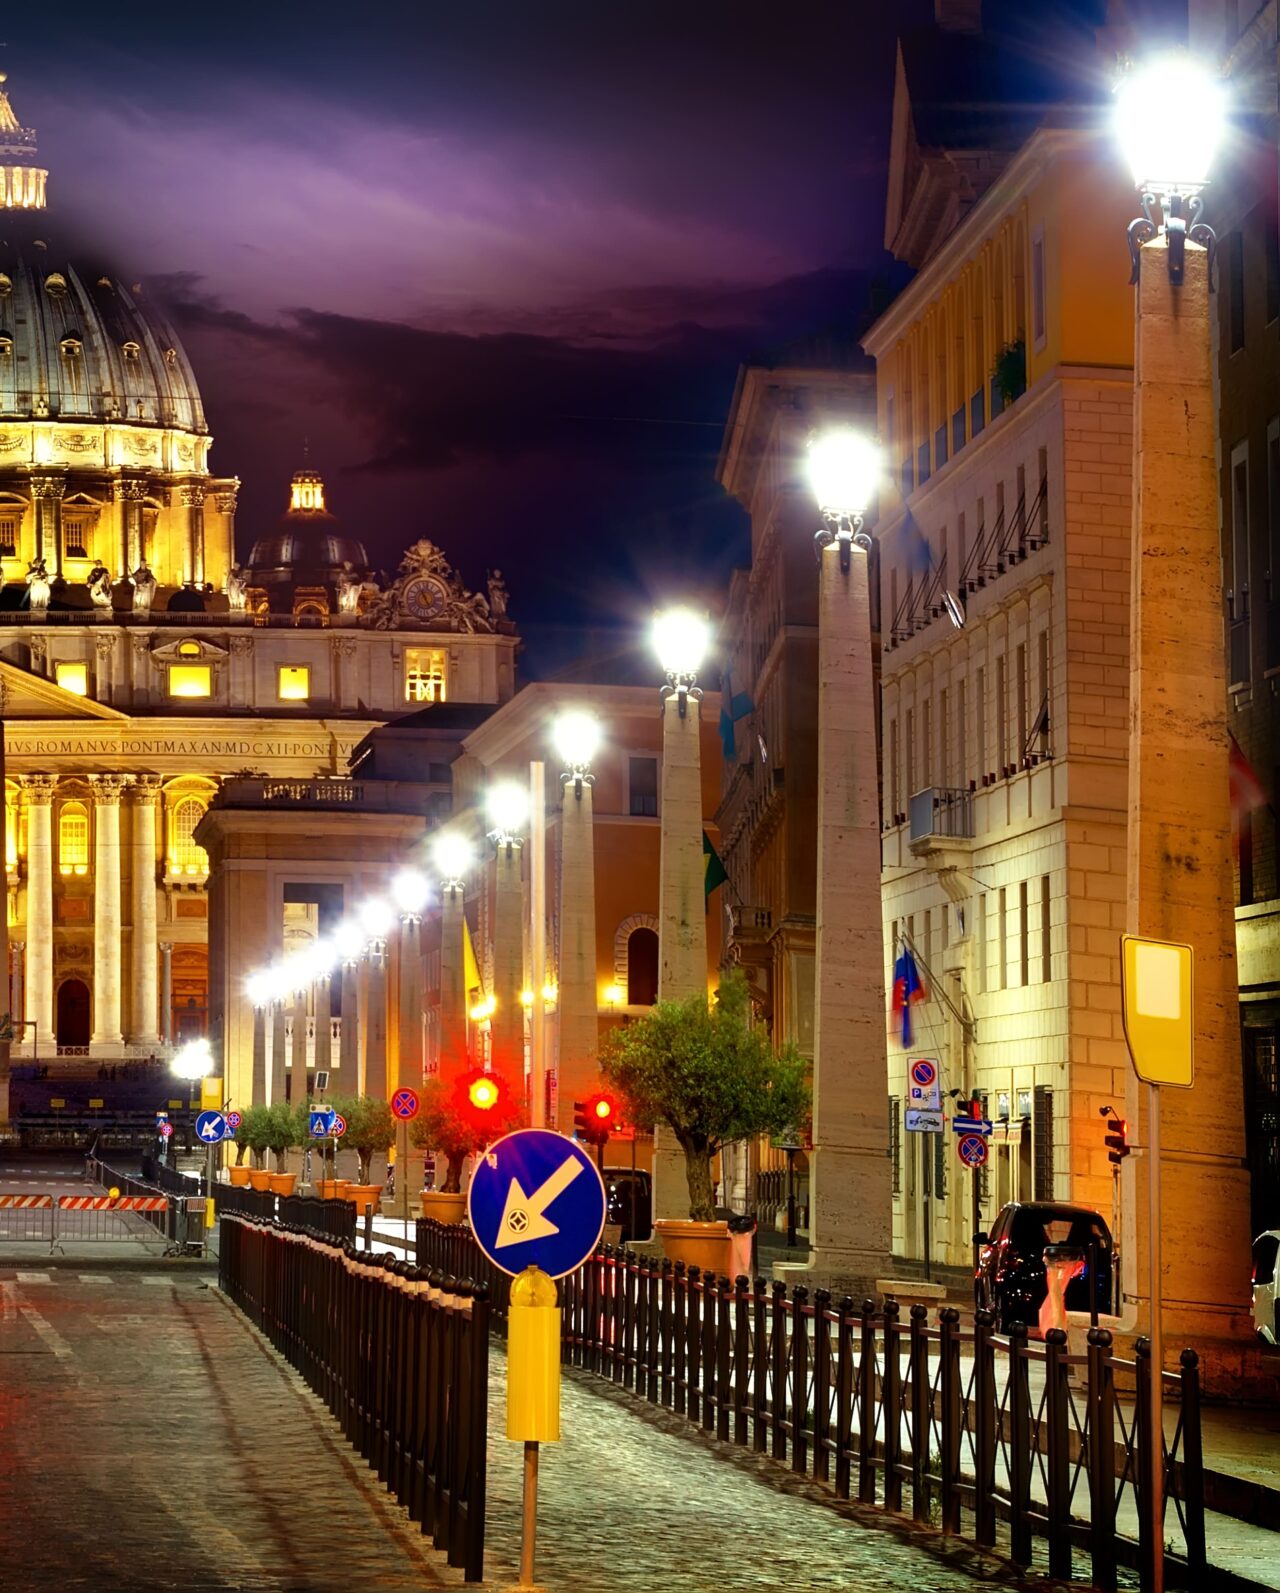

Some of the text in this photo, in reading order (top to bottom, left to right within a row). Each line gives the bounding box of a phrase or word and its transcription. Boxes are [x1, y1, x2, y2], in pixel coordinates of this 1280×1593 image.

[36, 740, 118, 753] ROMANVS
[121, 740, 162, 753] PONT
[225, 741, 288, 755] MDCXII
